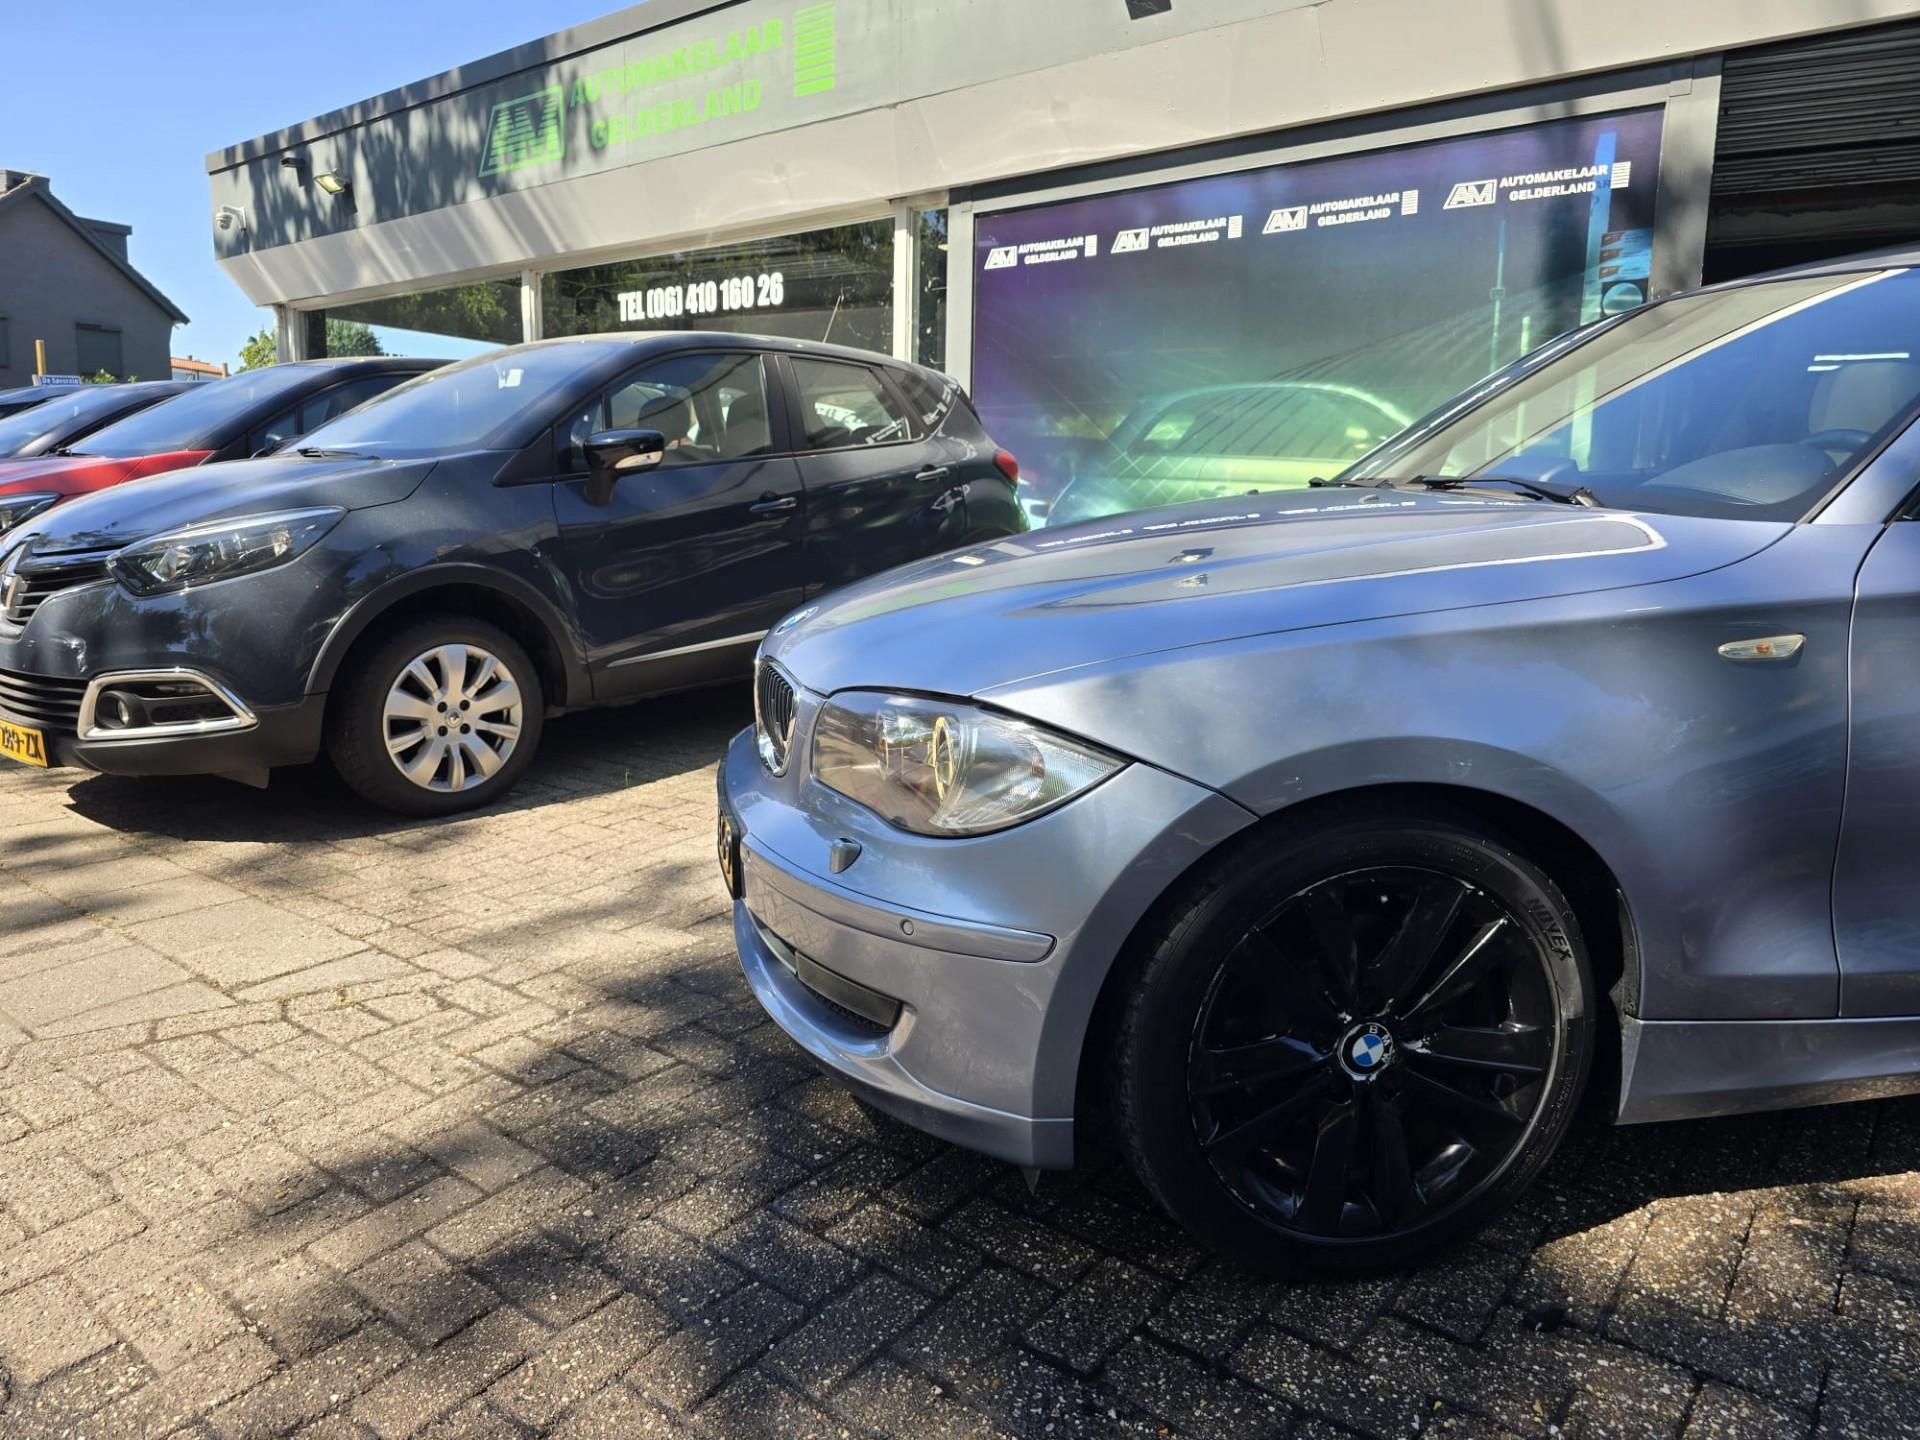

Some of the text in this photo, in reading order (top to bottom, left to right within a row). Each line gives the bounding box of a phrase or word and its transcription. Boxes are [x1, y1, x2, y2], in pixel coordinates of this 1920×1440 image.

[570, 18, 784, 108] AUTOMAKELAAR
[592, 79, 762, 150] GELDERLAND
[1500, 164, 1608, 188] AUTOMAKELAAR
[1509, 182, 1596, 202] GELDERLAND
[1309, 192, 1400, 215] AUTOMAKELAAR
[1150, 217, 1227, 237] AUTOMAKELAAR
[1317, 207, 1391, 227] GELDERLAND
[1018, 236, 1084, 254] AUTOMAKELAAR
[1157, 231, 1220, 248] GELDERLAND
[1024, 250, 1078, 265] GELDERLAND
[617, 271, 784, 322] TEL (06) 410 160 26
